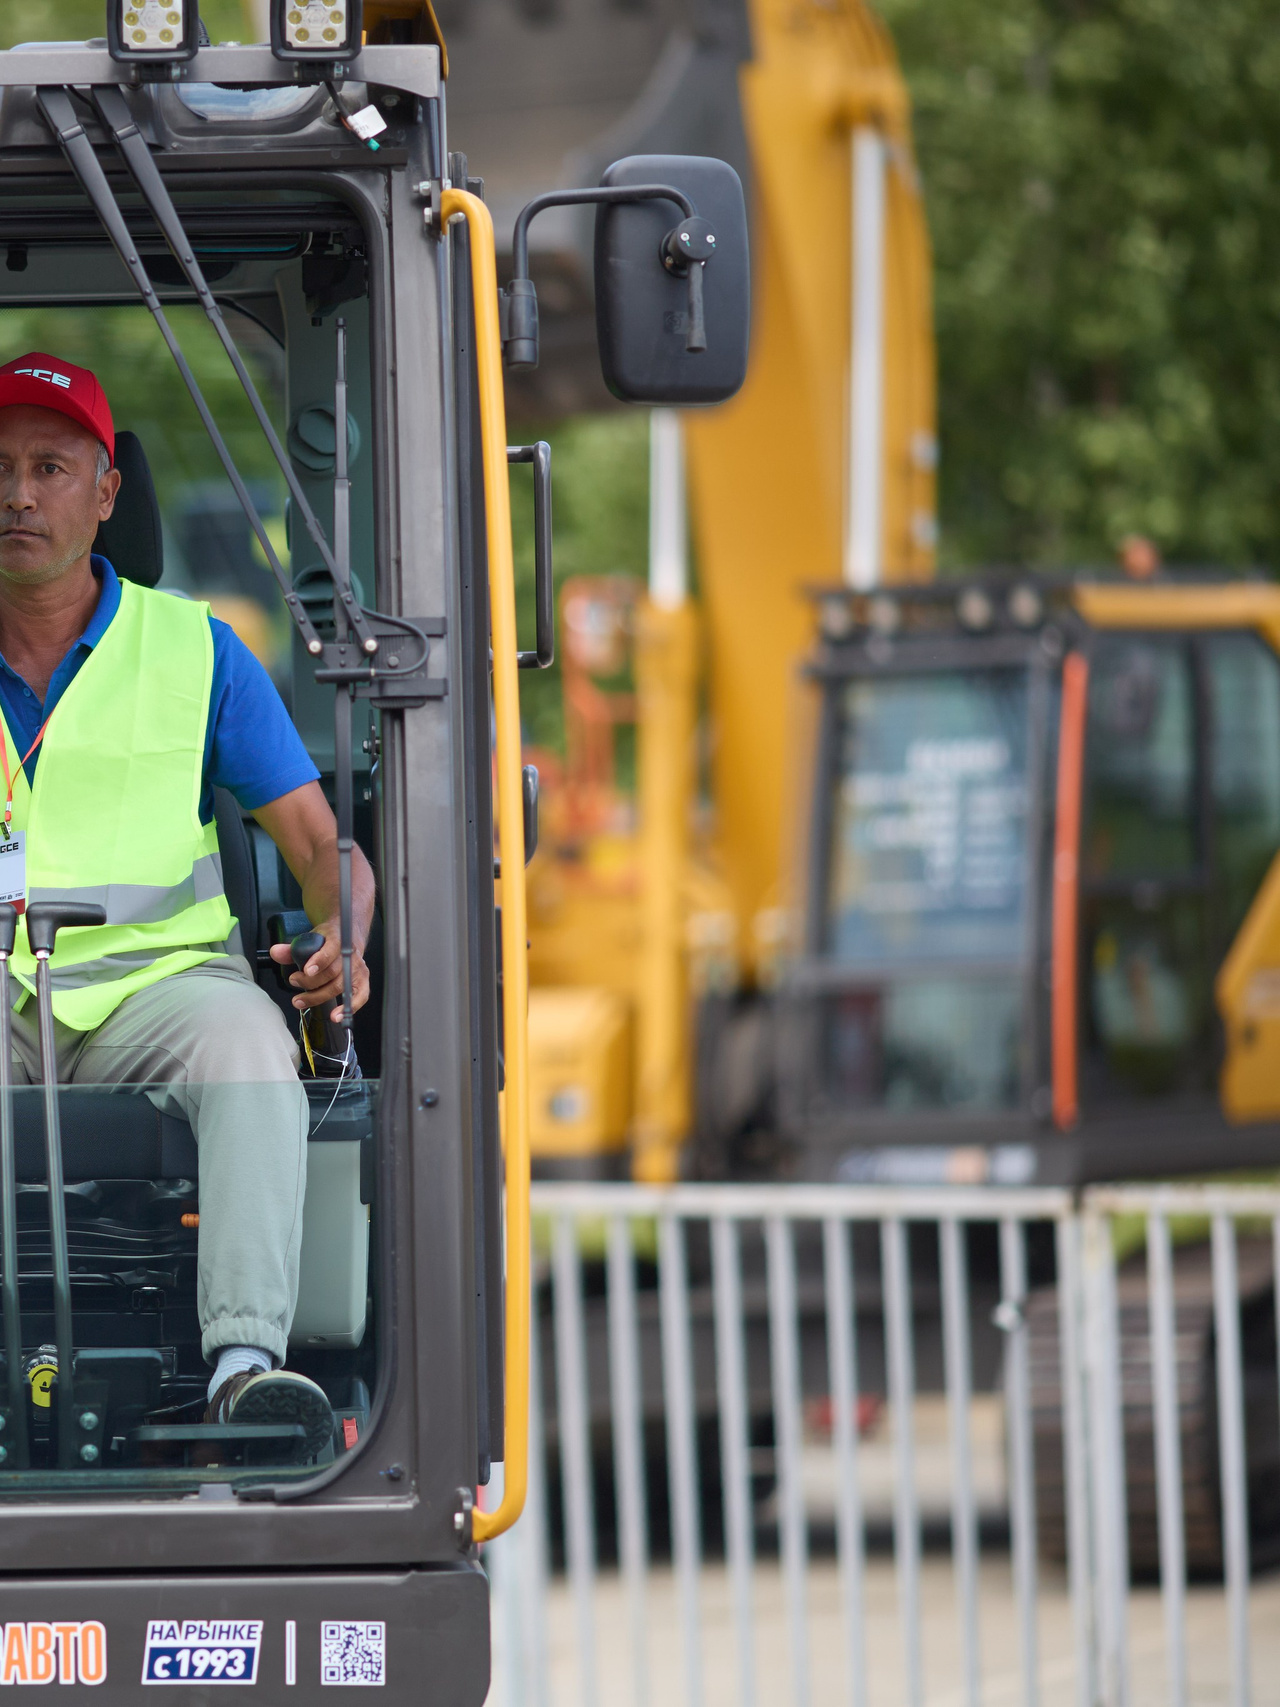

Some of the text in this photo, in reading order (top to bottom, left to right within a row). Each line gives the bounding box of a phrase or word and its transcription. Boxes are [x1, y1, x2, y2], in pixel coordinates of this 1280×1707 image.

[150, 1624, 259, 1640] НА РЫНКЕ
[175, 1648, 246, 1677] 1993
